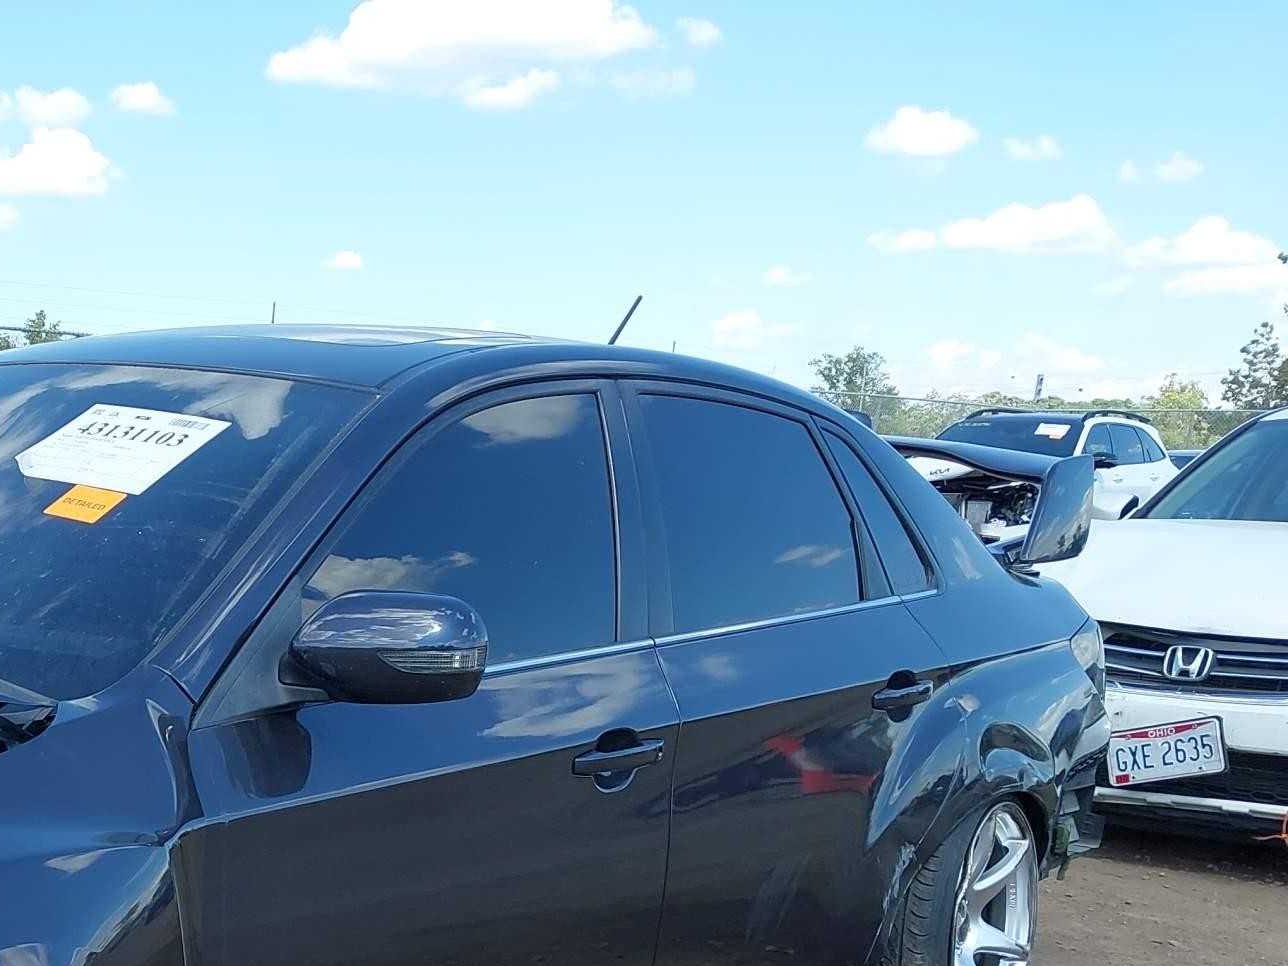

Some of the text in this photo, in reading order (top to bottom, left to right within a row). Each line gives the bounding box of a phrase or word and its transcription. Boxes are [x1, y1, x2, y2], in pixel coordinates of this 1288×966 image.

[77, 421, 190, 447] 43131103
[62, 497, 106, 511] DETAILED
[1147, 726, 1176, 739] OHIO
[1115, 733, 1214, 773] GXE 2635
